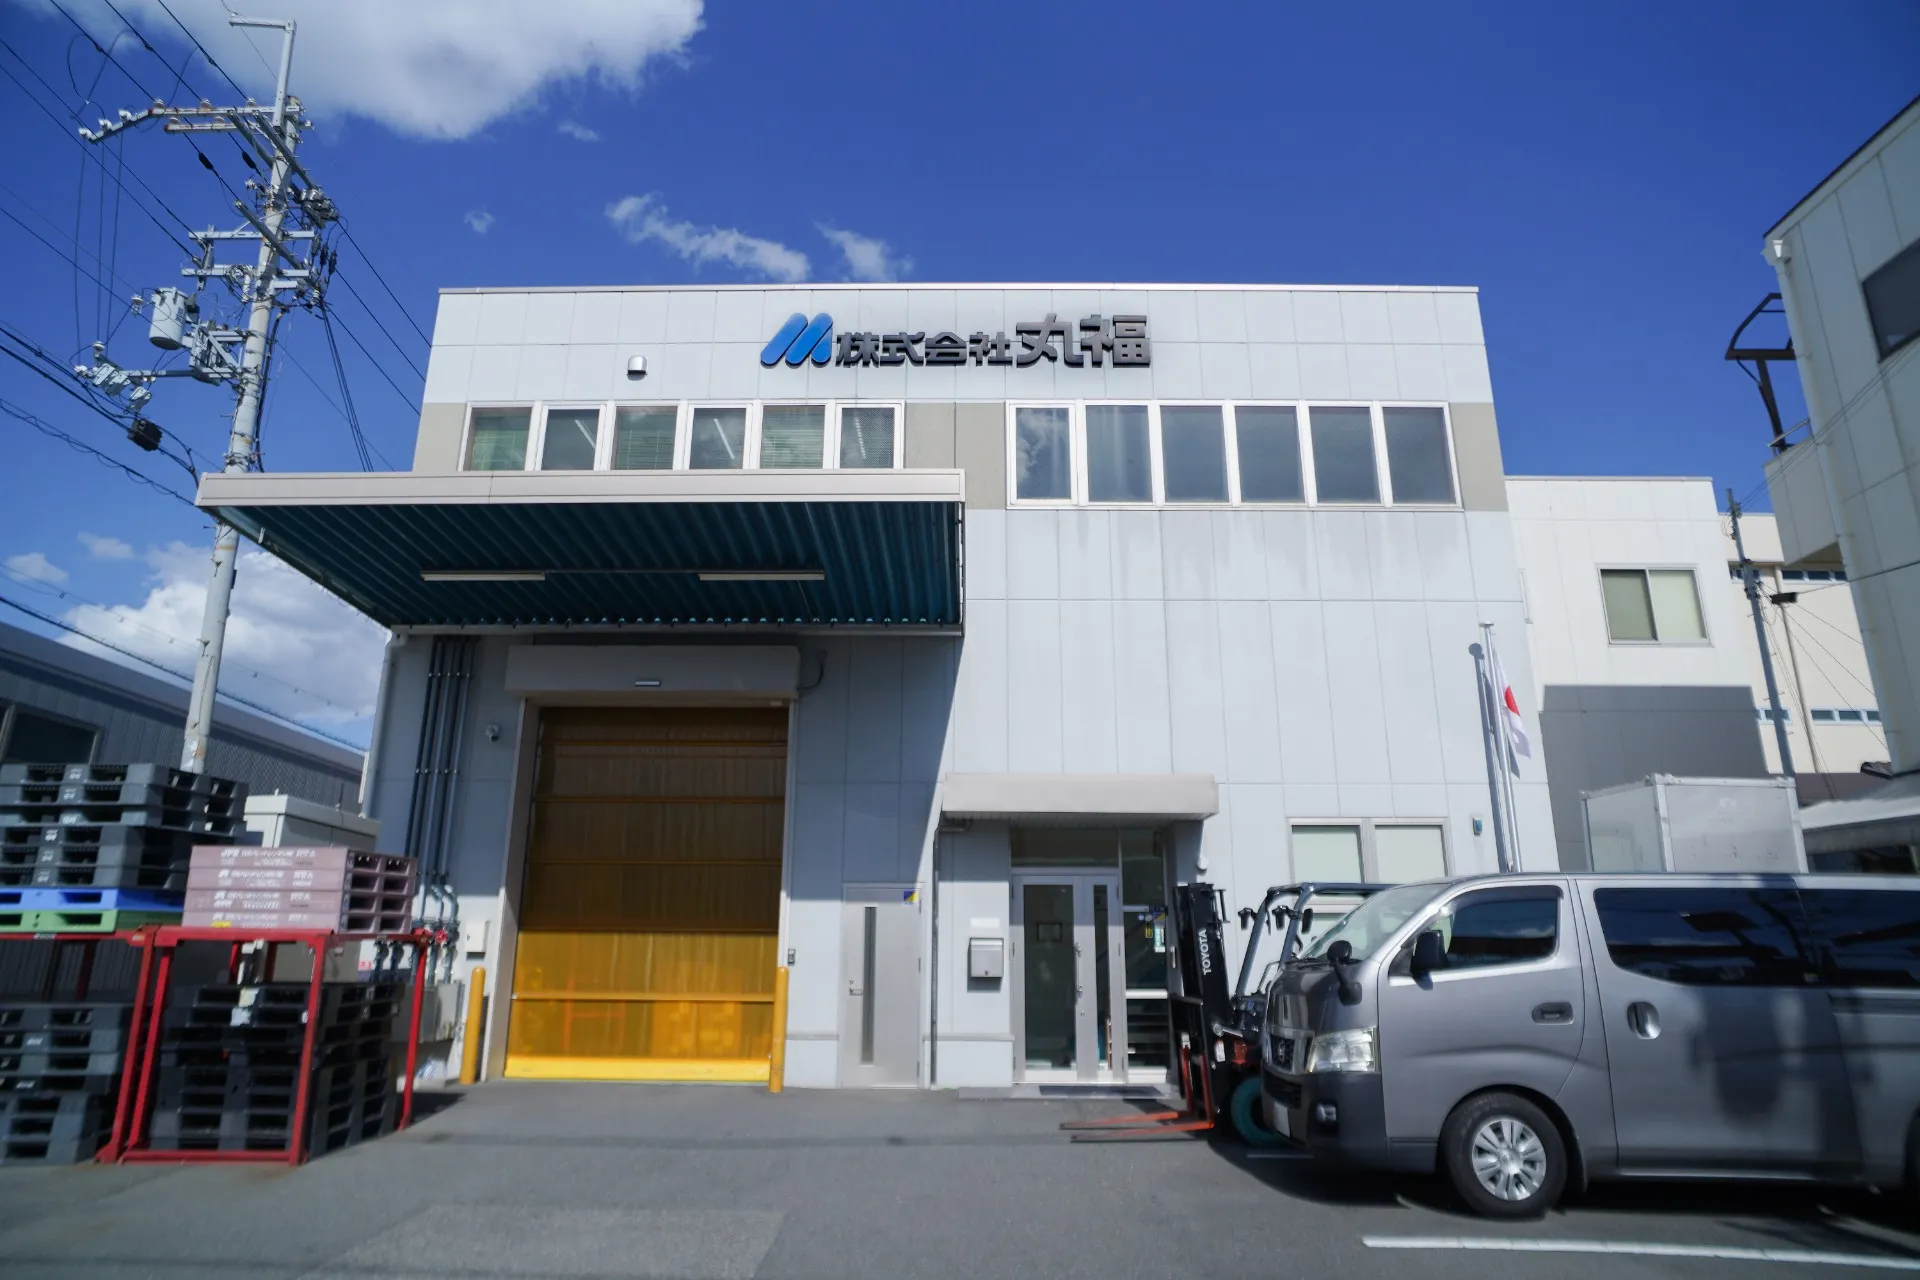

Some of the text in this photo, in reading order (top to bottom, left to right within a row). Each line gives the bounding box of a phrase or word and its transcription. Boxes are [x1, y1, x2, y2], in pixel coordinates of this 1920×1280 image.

[835, 313, 1151, 368] 株式会社丸福
[1198, 928, 1212, 976] TOYOTA
